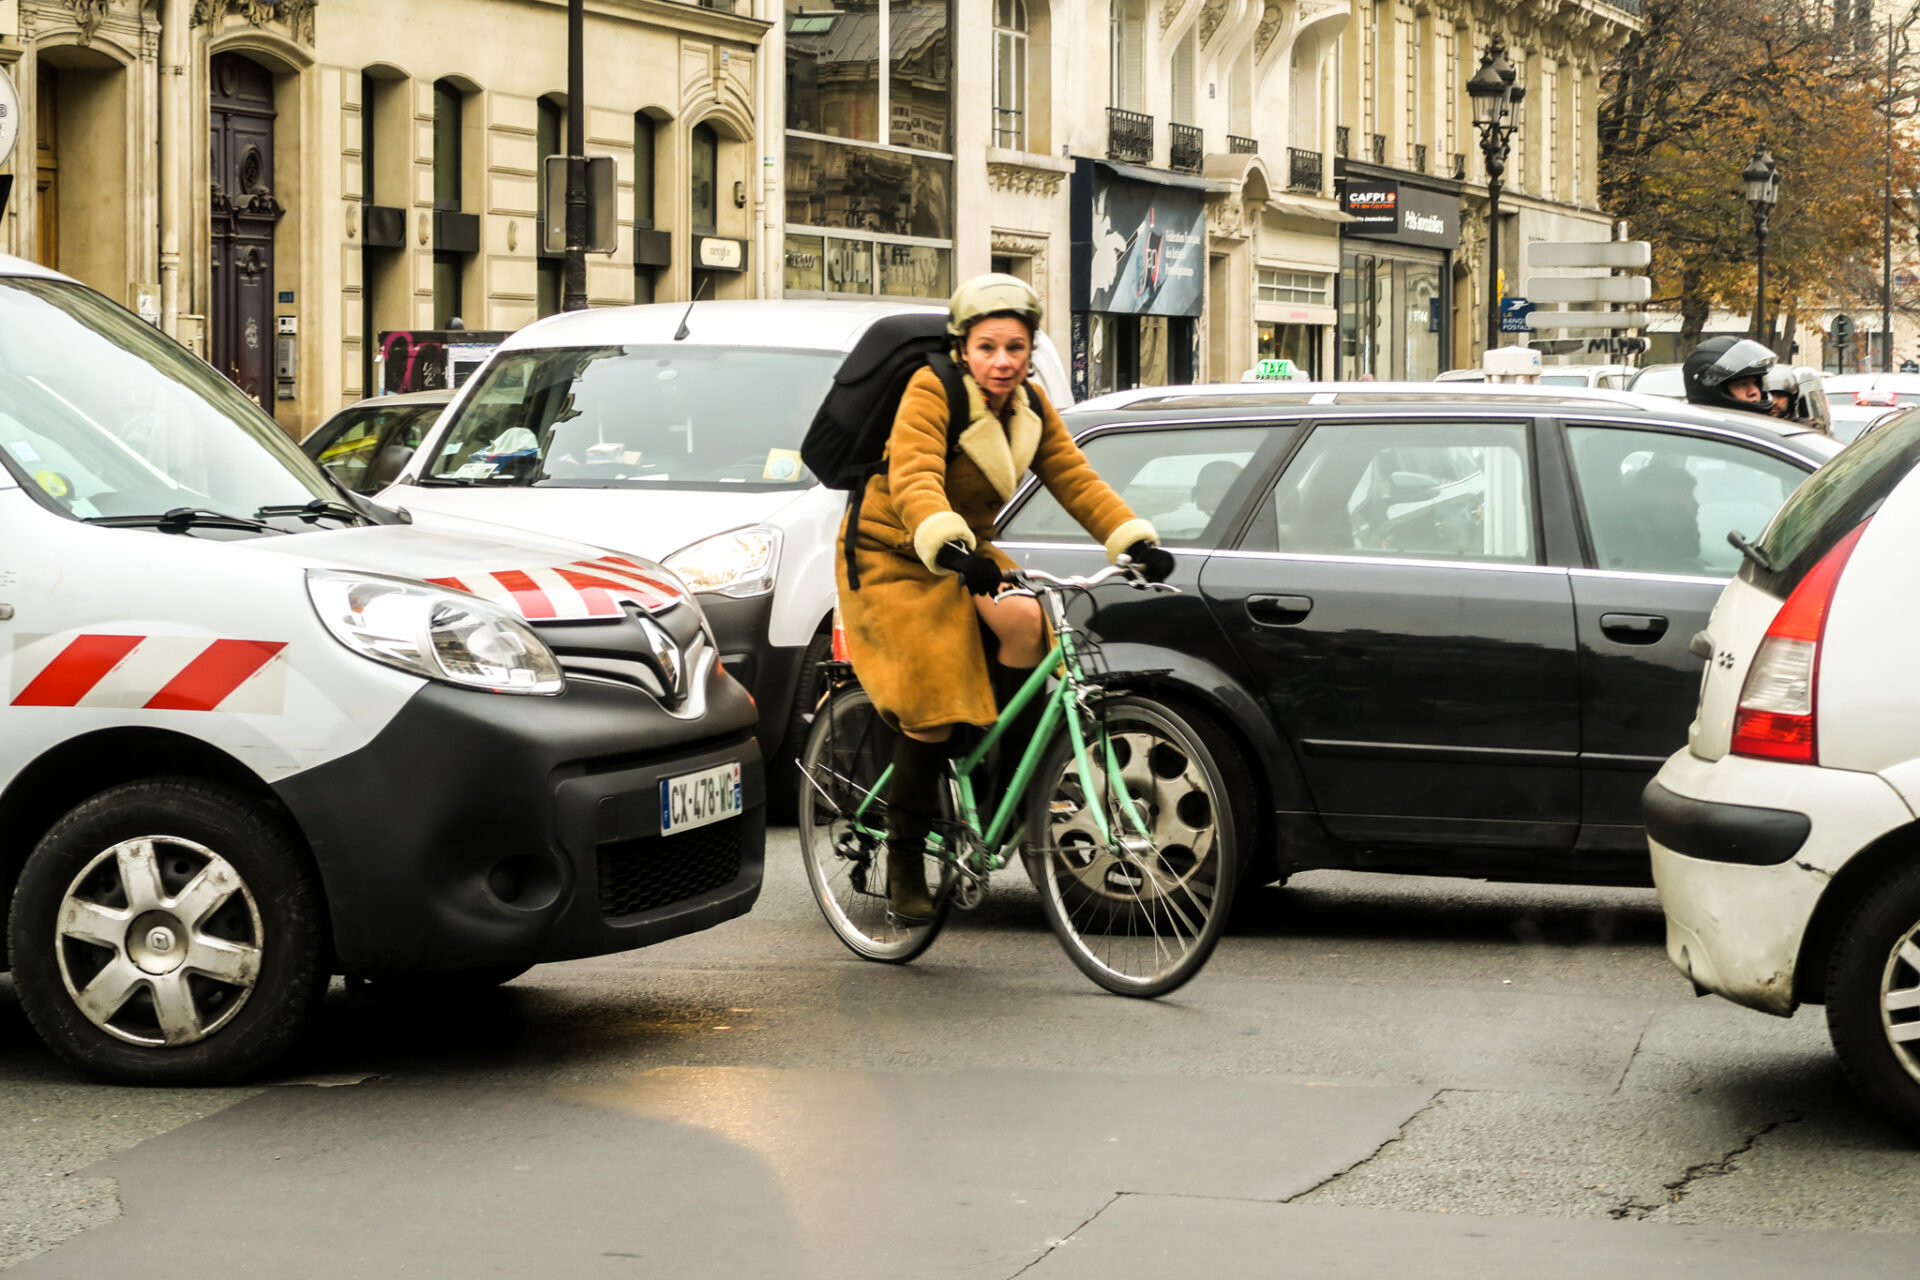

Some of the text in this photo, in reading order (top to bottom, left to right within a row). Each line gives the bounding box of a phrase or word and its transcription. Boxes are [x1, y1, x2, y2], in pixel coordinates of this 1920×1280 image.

[1349, 192, 1386, 202] CAFPI
[1261, 361, 1288, 374] TAXI
[671, 772, 733, 825] CX-478-WG
